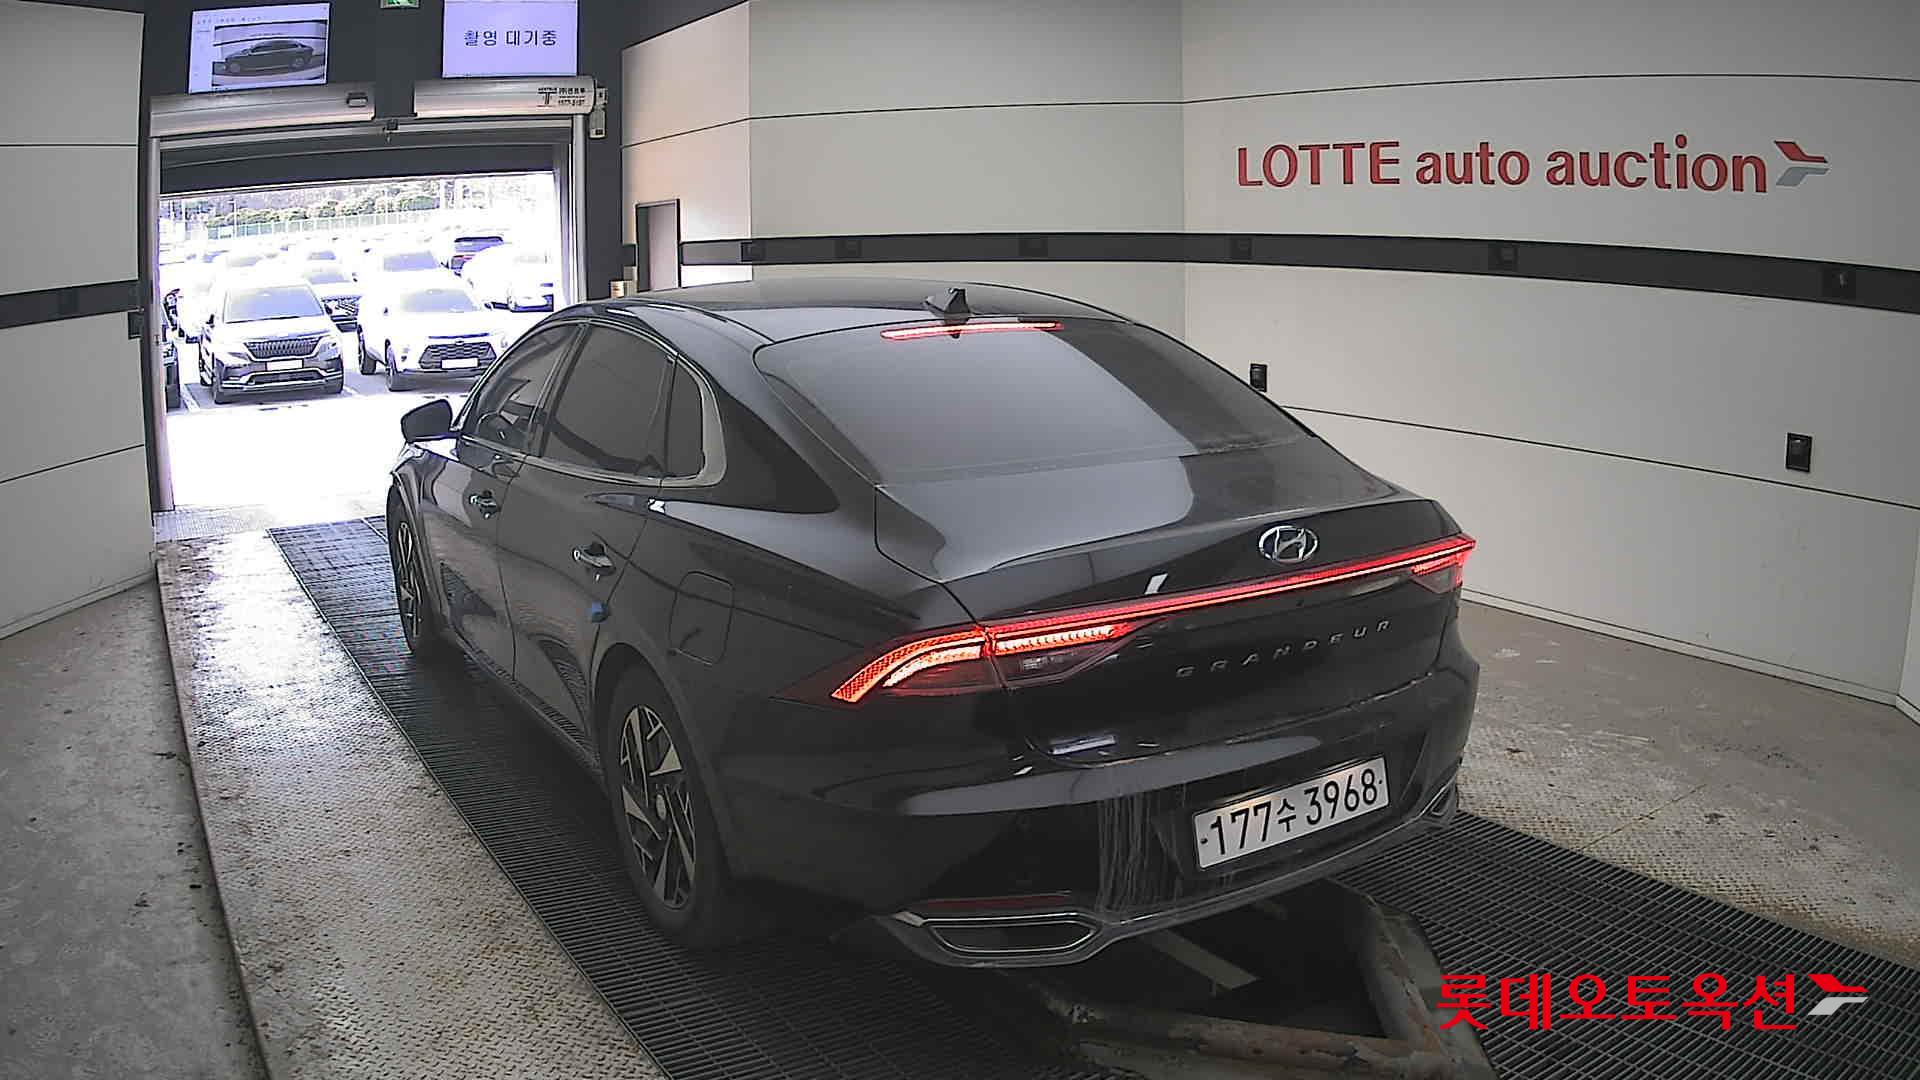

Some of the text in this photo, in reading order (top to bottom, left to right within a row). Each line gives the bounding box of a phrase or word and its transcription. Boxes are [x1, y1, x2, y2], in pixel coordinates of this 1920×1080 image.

[464, 29, 558, 47] 촬영 대기중
[1237, 134, 1767, 193] LOTTE auto auction
[1175, 620, 1390, 678] GRANDEUR
[1210, 768, 1378, 855] 177수 3968
